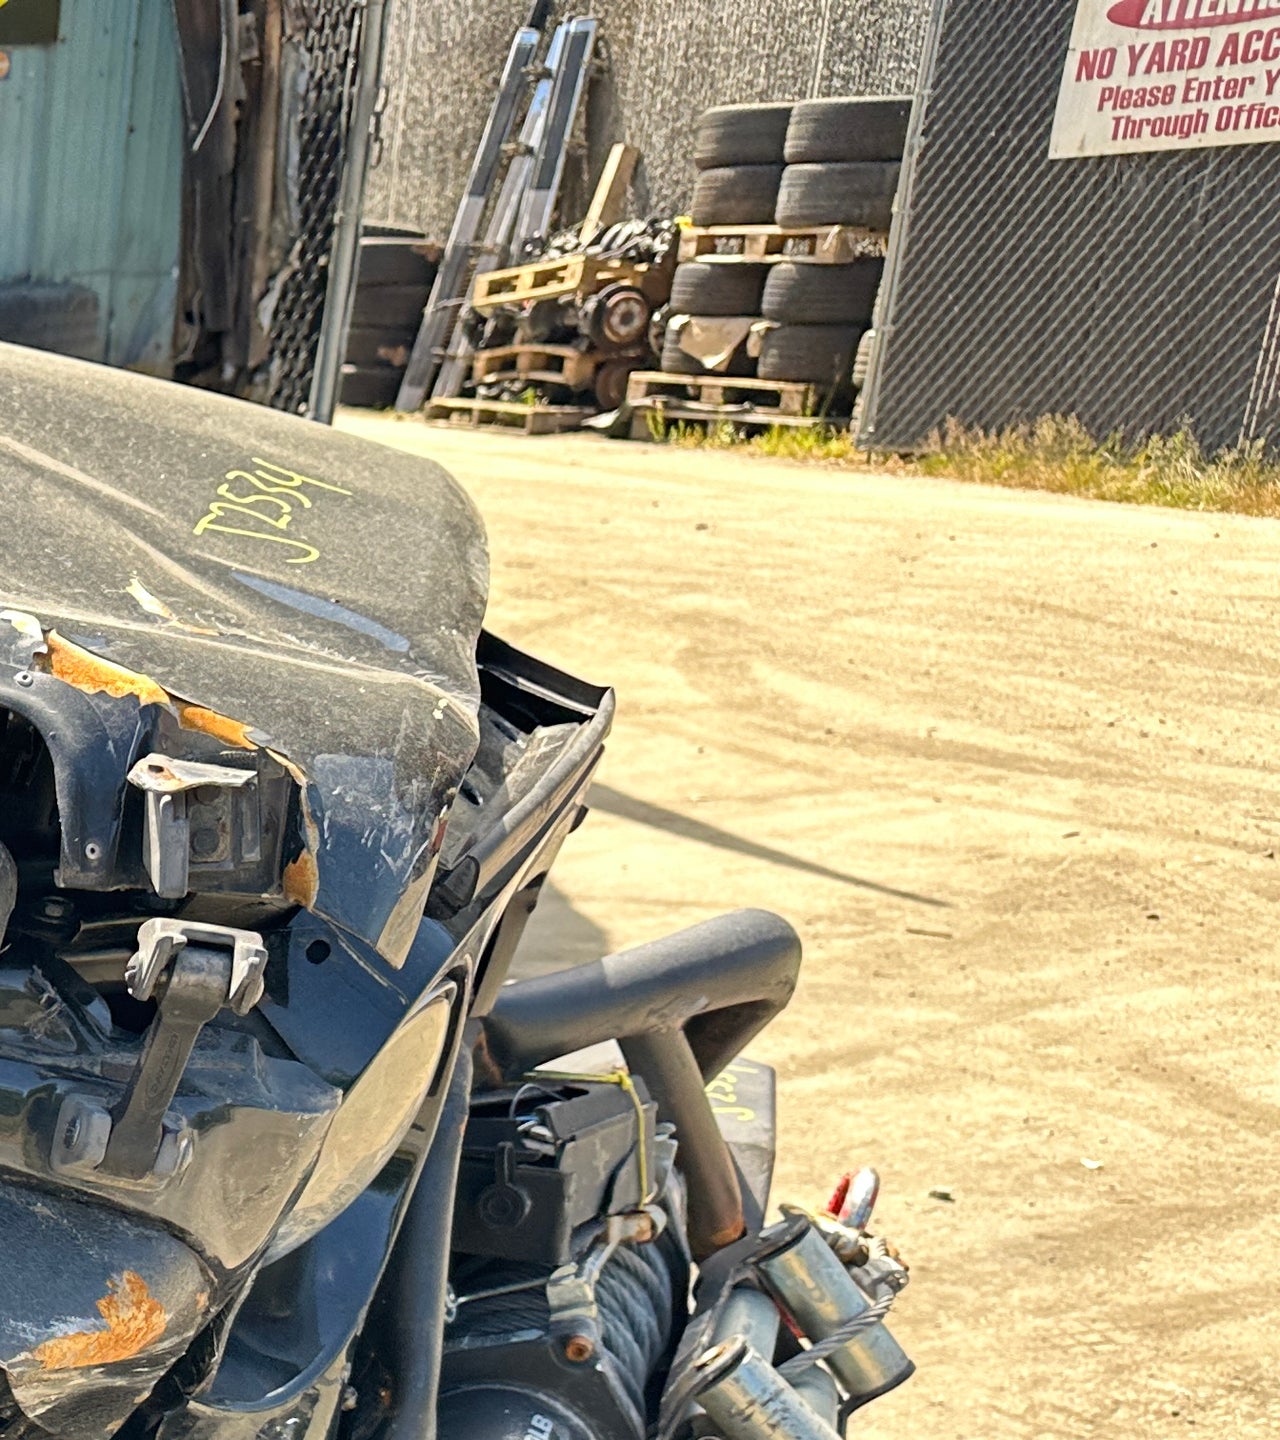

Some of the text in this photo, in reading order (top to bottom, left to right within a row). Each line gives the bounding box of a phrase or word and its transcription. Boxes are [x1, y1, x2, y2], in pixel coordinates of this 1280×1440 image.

[1075, 47, 1117, 82] NO
[1128, 36, 1211, 77] YARD
[1097, 83, 1176, 112] Please
[1182, 75, 1255, 104] Enter
[1111, 102, 1280, 141] Through Offic
